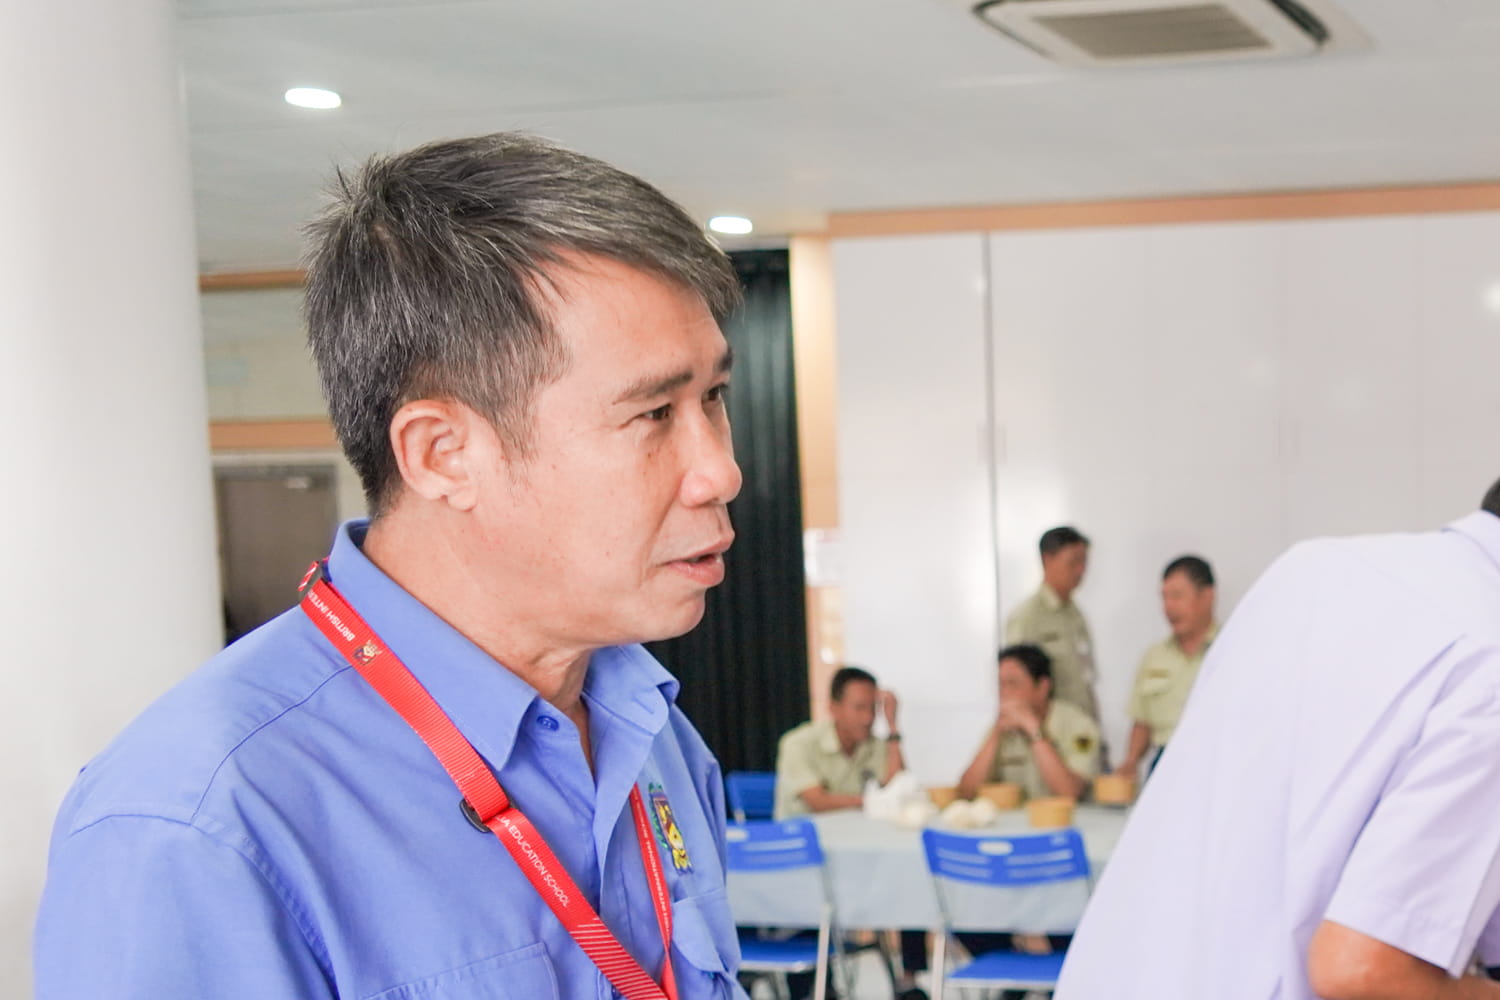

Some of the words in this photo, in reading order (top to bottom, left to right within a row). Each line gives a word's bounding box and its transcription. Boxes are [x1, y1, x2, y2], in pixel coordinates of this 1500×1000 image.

[326, 610, 356, 642] BRITISH
[509, 825, 548, 875] EDUCATION
[544, 873, 570, 907] SCHOOL
